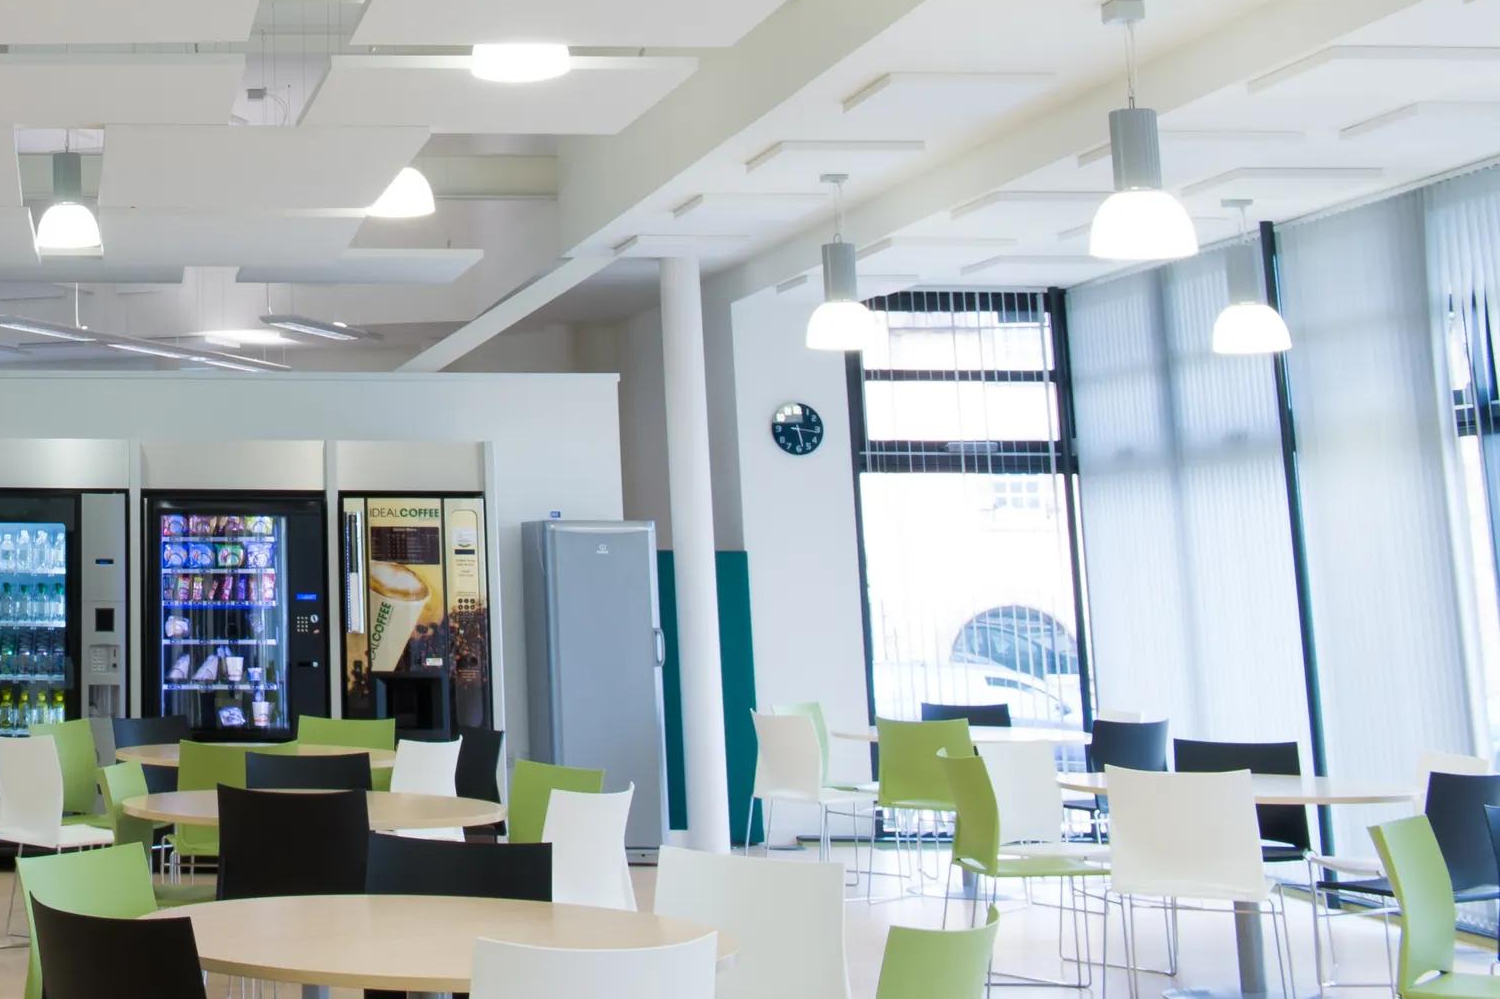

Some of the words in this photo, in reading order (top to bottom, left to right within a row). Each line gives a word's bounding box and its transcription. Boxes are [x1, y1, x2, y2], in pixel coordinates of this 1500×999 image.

[811, 414, 817, 422] 2
[775, 425, 782, 433] 9
[814, 425, 820, 433] 3
[811, 436, 817, 444] 4
[786, 442, 792, 450] 7
[795, 444, 802, 453] 6
[805, 442, 811, 450] 5
